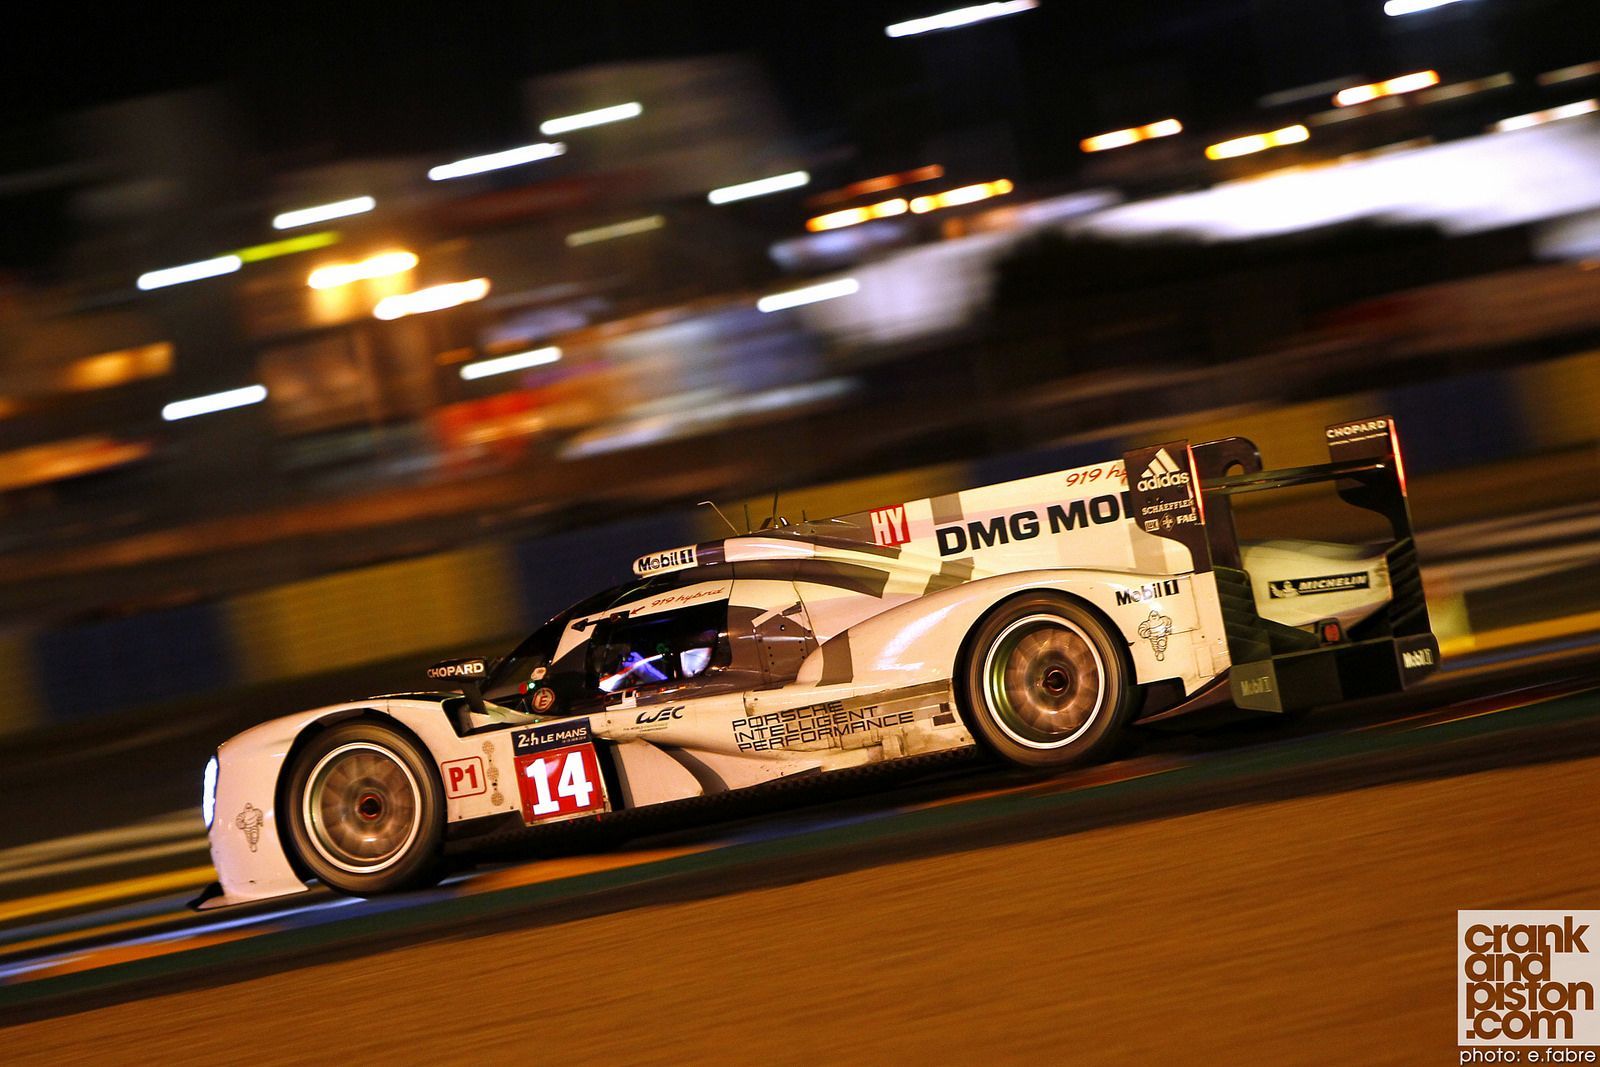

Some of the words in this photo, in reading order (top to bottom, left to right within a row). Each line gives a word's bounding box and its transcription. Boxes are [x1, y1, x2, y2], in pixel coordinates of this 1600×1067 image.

[1326, 420, 1387, 438] CHOPARD
[1066, 468, 1102, 487] 919
[1137, 472, 1190, 492] adidas
[1141, 499, 1194, 516] SCHAEFFLER
[870, 506, 905, 546] HY
[1176, 513, 1198, 525] FAG
[936, 512, 1040, 556] DMG
[638, 552, 678, 572] Mobil
[680, 549, 694, 564] 1
[1115, 582, 1162, 606] Mobil
[1163, 579, 1179, 596] 1
[1299, 575, 1367, 590] MICHELIN
[676, 587, 725, 604] hybrid
[427, 662, 484, 678] CHOPARD
[636, 705, 685, 724] WEC
[732, 700, 843, 731] PORSCHE
[734, 706, 878, 743] INTELLIGENT
[540, 733, 555, 744] LE
[556, 727, 588, 741] MANS
[737, 711, 915, 753] PERFORMANCE
[448, 764, 478, 792] P1
[525, 751, 594, 815] 14
